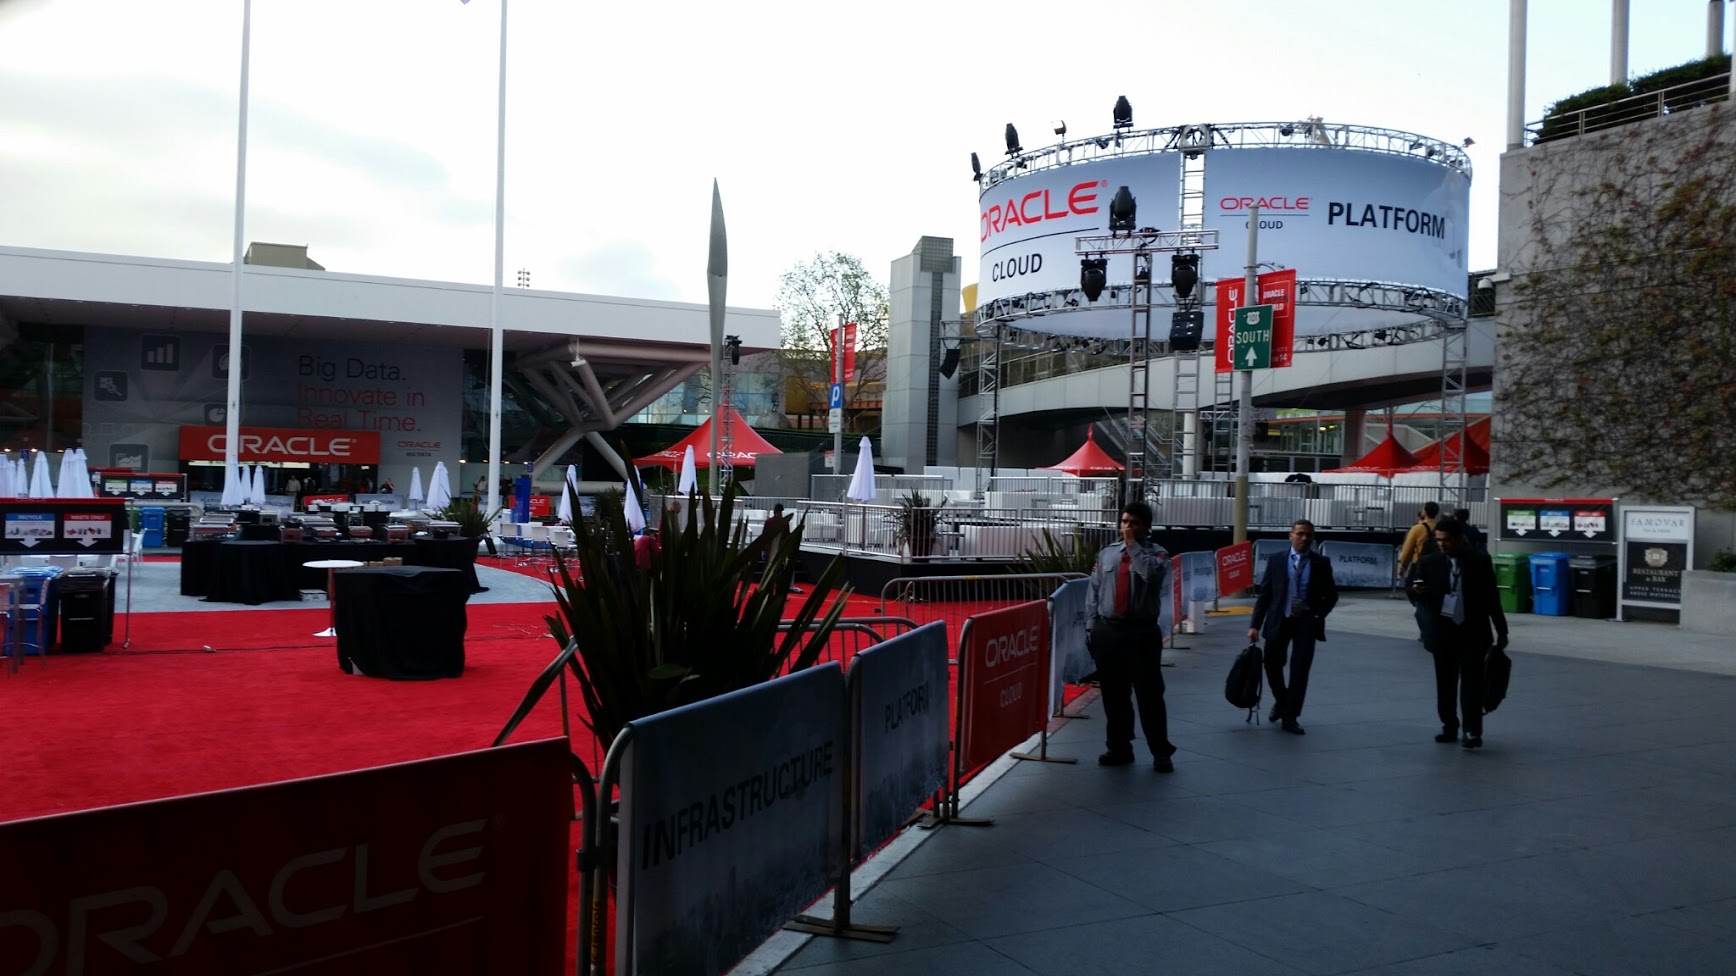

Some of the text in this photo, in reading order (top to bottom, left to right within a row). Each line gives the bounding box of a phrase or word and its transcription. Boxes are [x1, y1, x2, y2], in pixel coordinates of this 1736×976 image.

[1220, 197, 1309, 210] ORACLE
[1245, 220, 1283, 230] OUD
[1328, 201, 1446, 240] PLATFORM
[992, 253, 1043, 282] CLOUD
[1236, 329, 1270, 344] SOUTH
[298, 354, 406, 382] Big Data.
[298, 382, 425, 407] Innovate in
[831, 385, 841, 407] P
[296, 406, 422, 432] Real Time.
[207, 434, 352, 457] ORACLE
[397, 440, 441, 449] ORACLE
[1222, 550, 1248, 566] ORACLE
[1339, 555, 1377, 565] PLATFORM
[1632, 568, 1679, 577] RESTAURANT
[985, 625, 1040, 668] ORACLE
[1000, 682, 1023, 708] CLOUD
[642, 740, 833, 870] INFRASTRUCTURE
